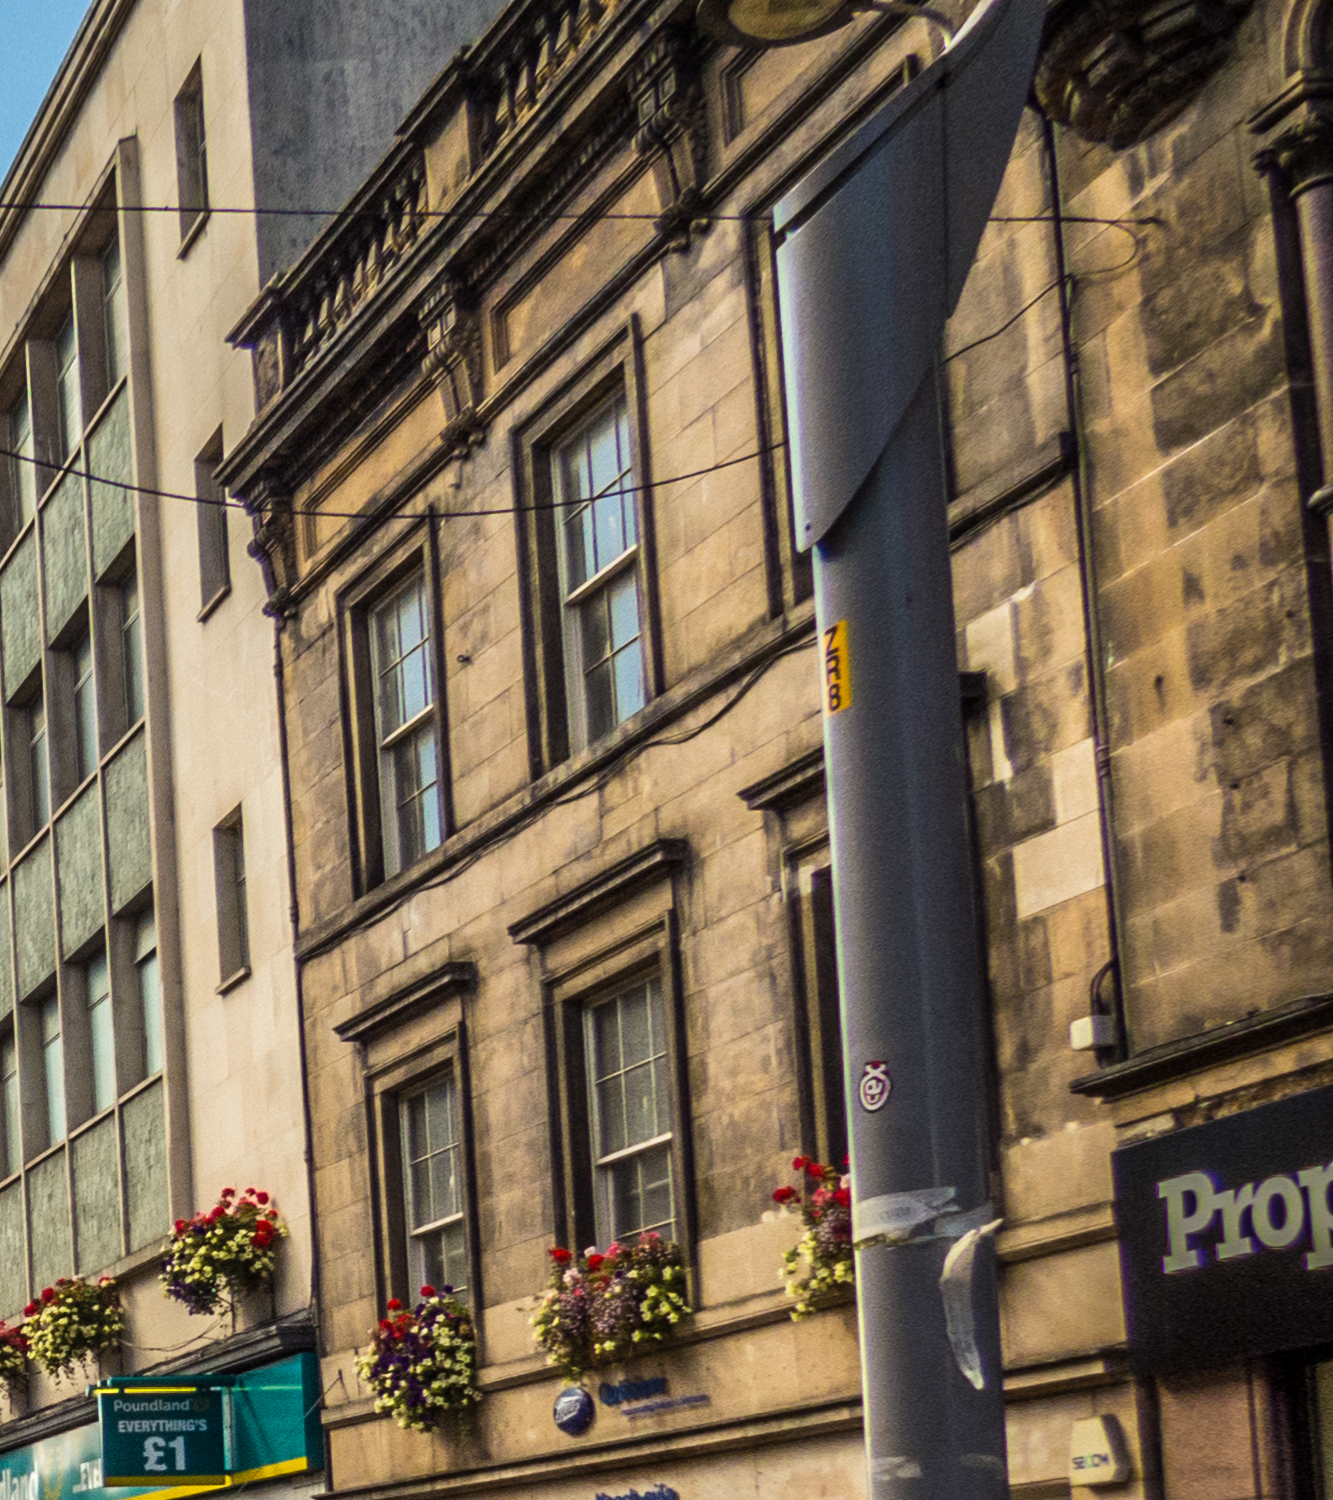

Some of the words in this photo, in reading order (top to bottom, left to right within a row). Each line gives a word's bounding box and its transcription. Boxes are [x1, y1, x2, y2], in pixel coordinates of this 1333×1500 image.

[114, 1399, 190, 1412] Poundland
[118, 1419, 208, 1433] EVERYTHING'S
[143, 1436, 186, 1471] £1
